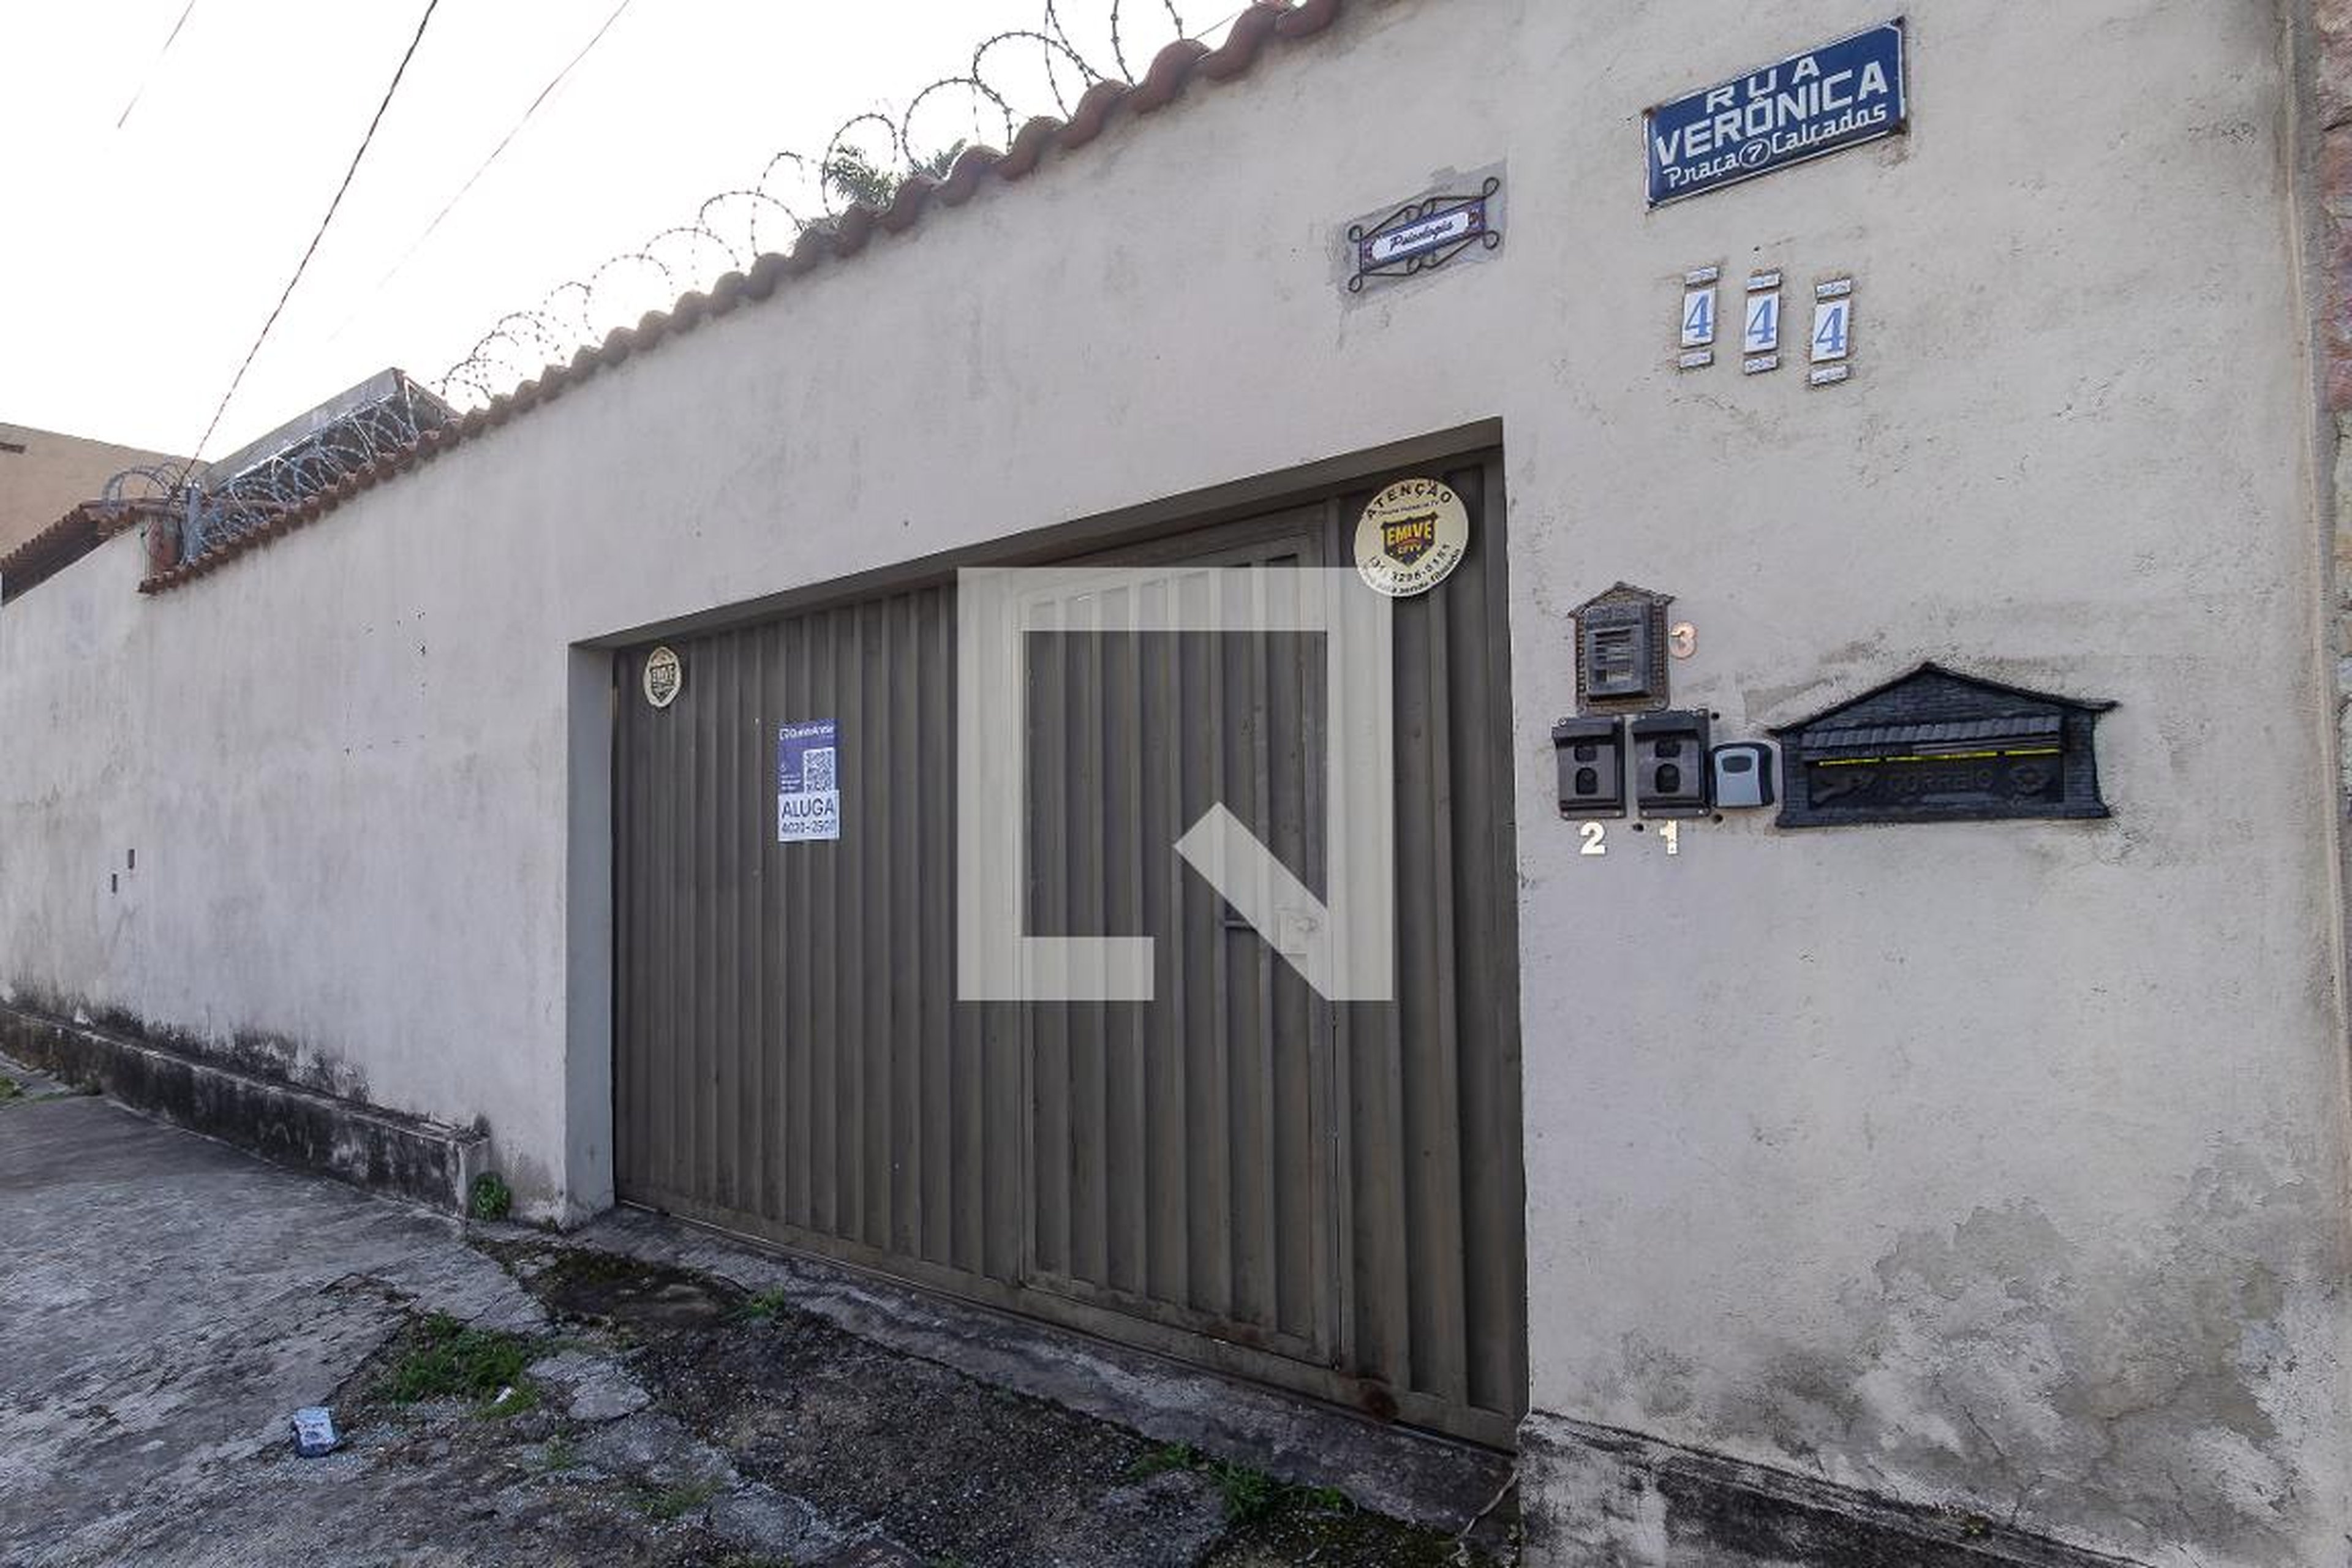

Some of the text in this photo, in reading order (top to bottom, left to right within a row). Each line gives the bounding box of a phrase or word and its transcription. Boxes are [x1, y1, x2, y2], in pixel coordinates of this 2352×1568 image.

[1706, 56, 1820, 113] RUA
[1656, 60, 1888, 166] VERÔNICA
[1662, 153, 1741, 188] Praça
[1748, 143, 1763, 162] 7
[1367, 479, 1452, 519] ATENÇÃO
[1387, 520, 1432, 545] EMIVE
[1671, 620, 1698, 660] 3
[782, 797, 834, 819] ALUGA
[1580, 822, 1606, 855] 2
[1659, 821, 1678, 855] 1
